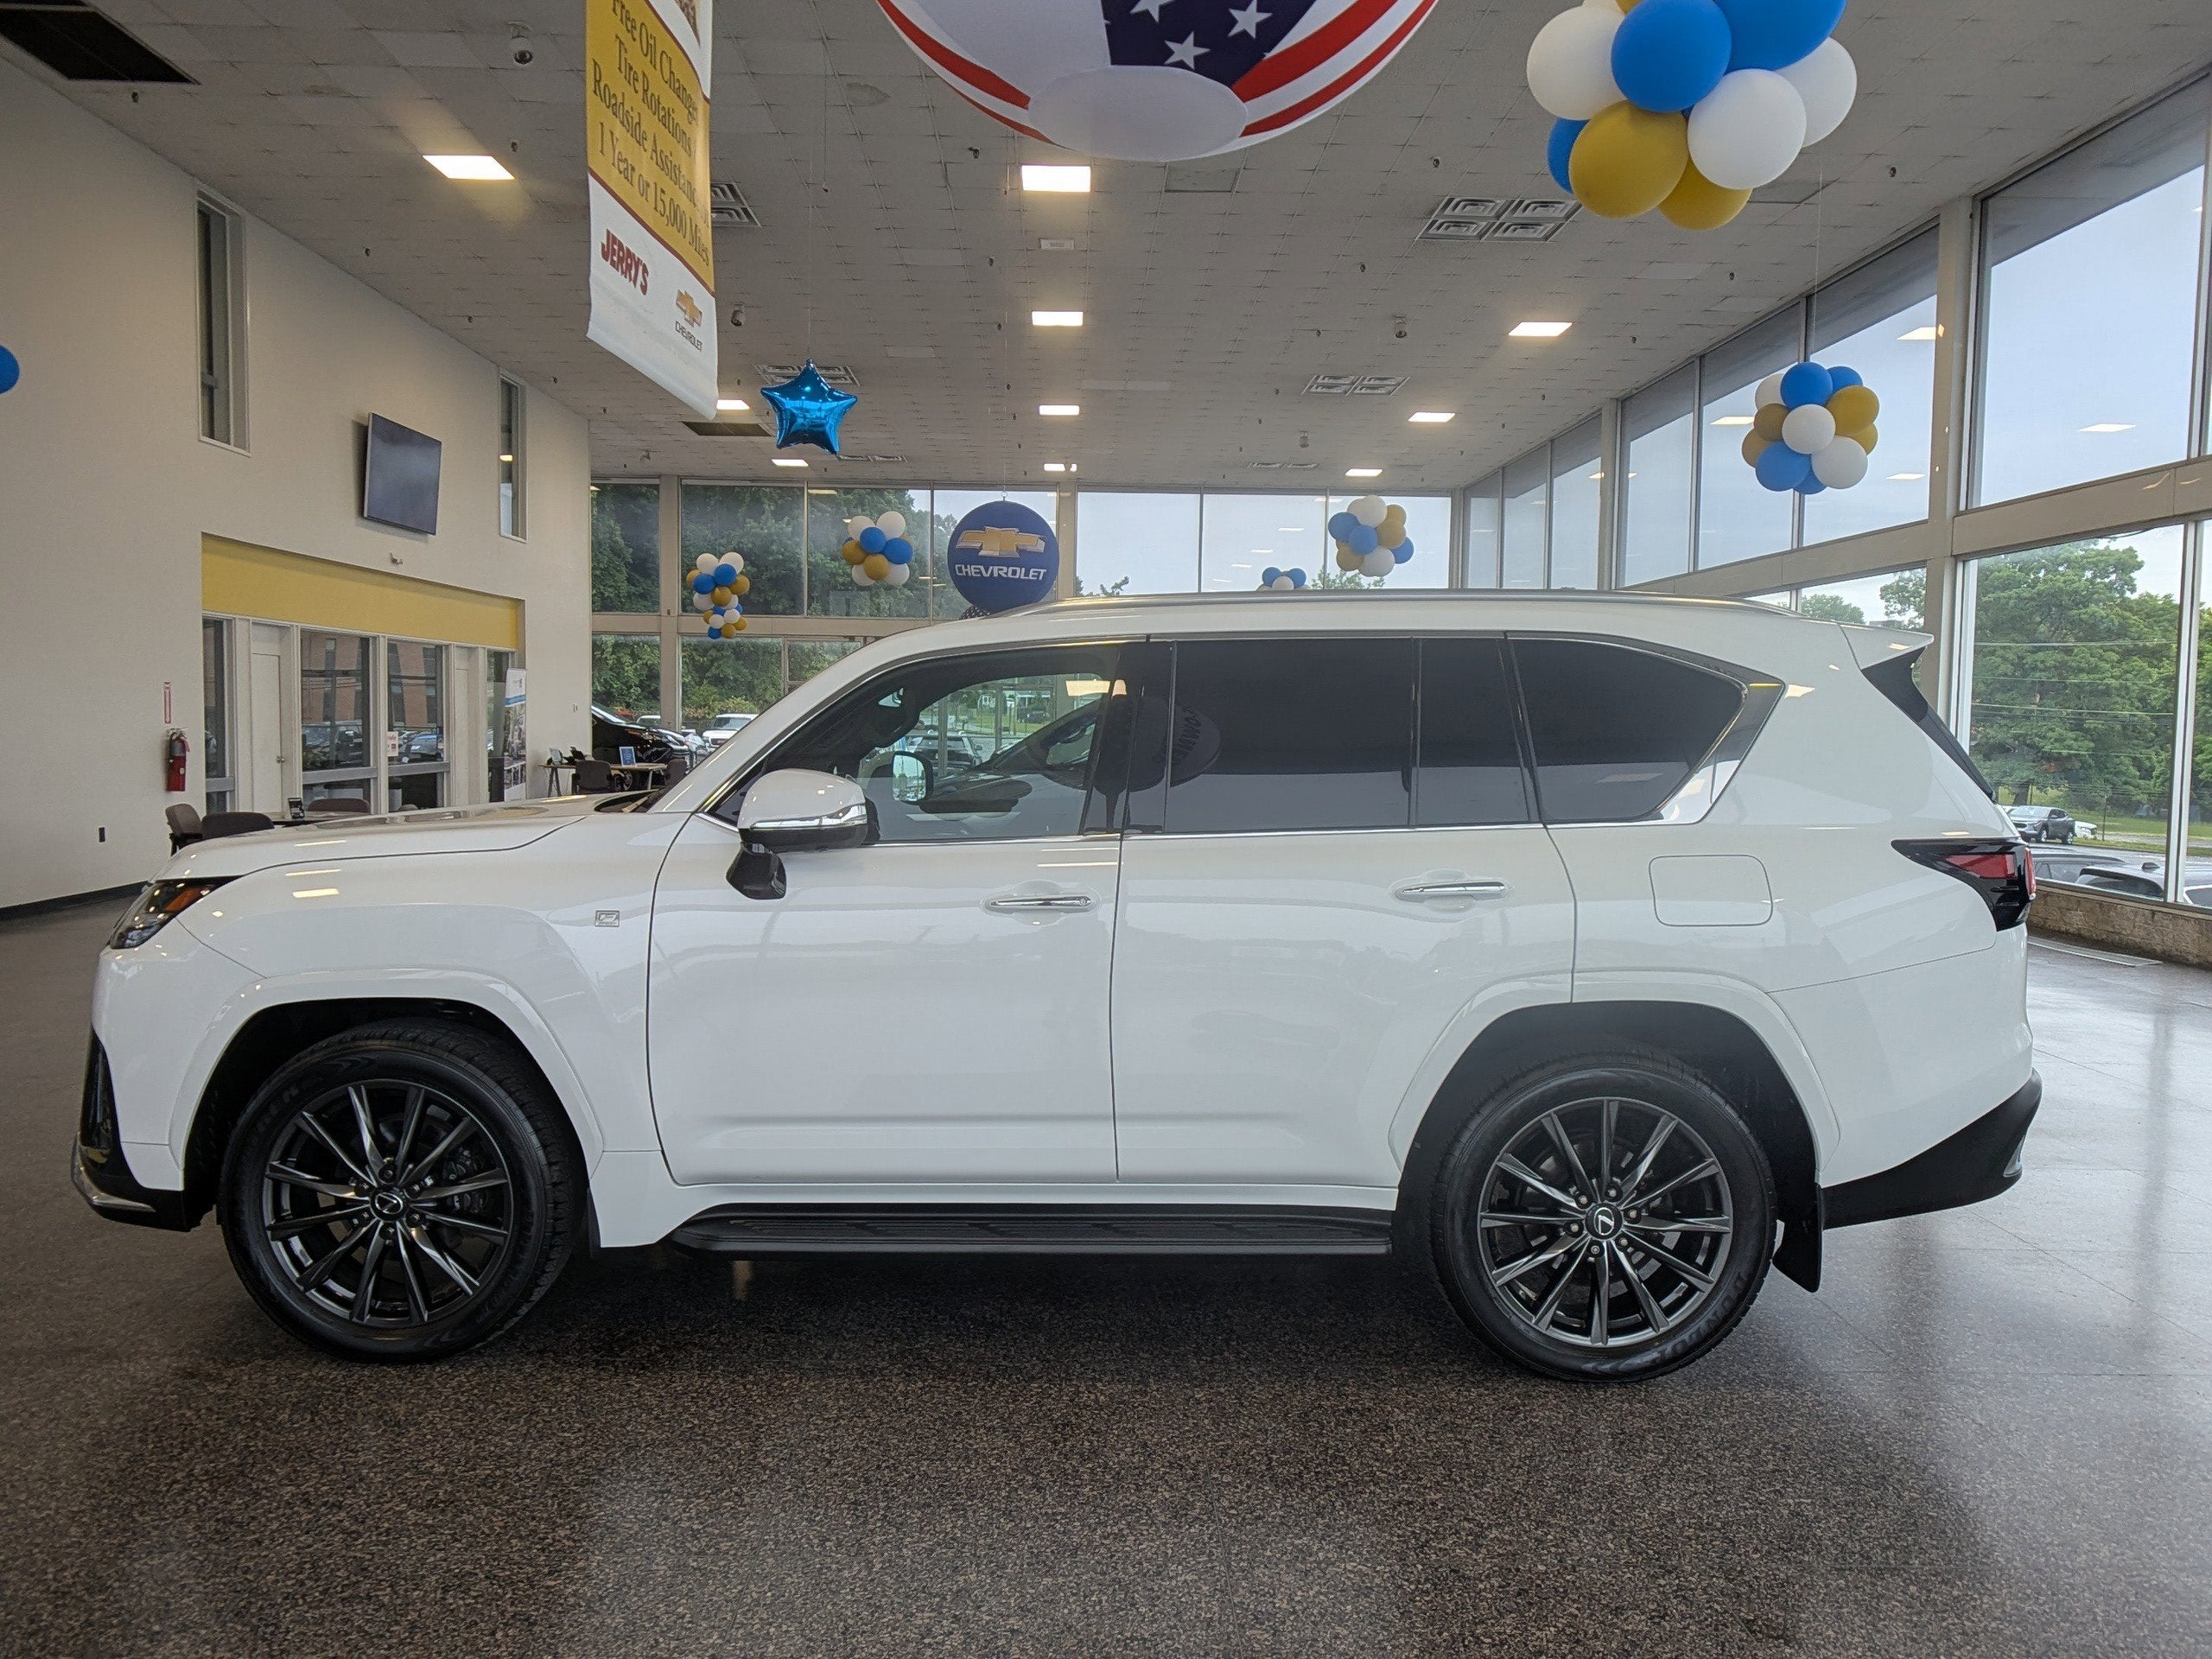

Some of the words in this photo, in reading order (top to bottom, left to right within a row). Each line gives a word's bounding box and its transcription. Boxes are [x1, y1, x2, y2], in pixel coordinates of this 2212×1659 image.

[639, 22, 657, 71] Oil
[592, 58, 648, 152] Roadside
[615, 34, 639, 93] Tire
[642, 71, 691, 157] Rotations
[600, 122, 606, 156] 1
[610, 130, 636, 187] Year
[638, 174, 650, 203] or
[652, 181, 687, 239] 15,000
[601, 228, 650, 296] JERRY'S
[675, 320, 702, 352] CHEVROLET
[955, 563, 1047, 581] CHEVROLET
